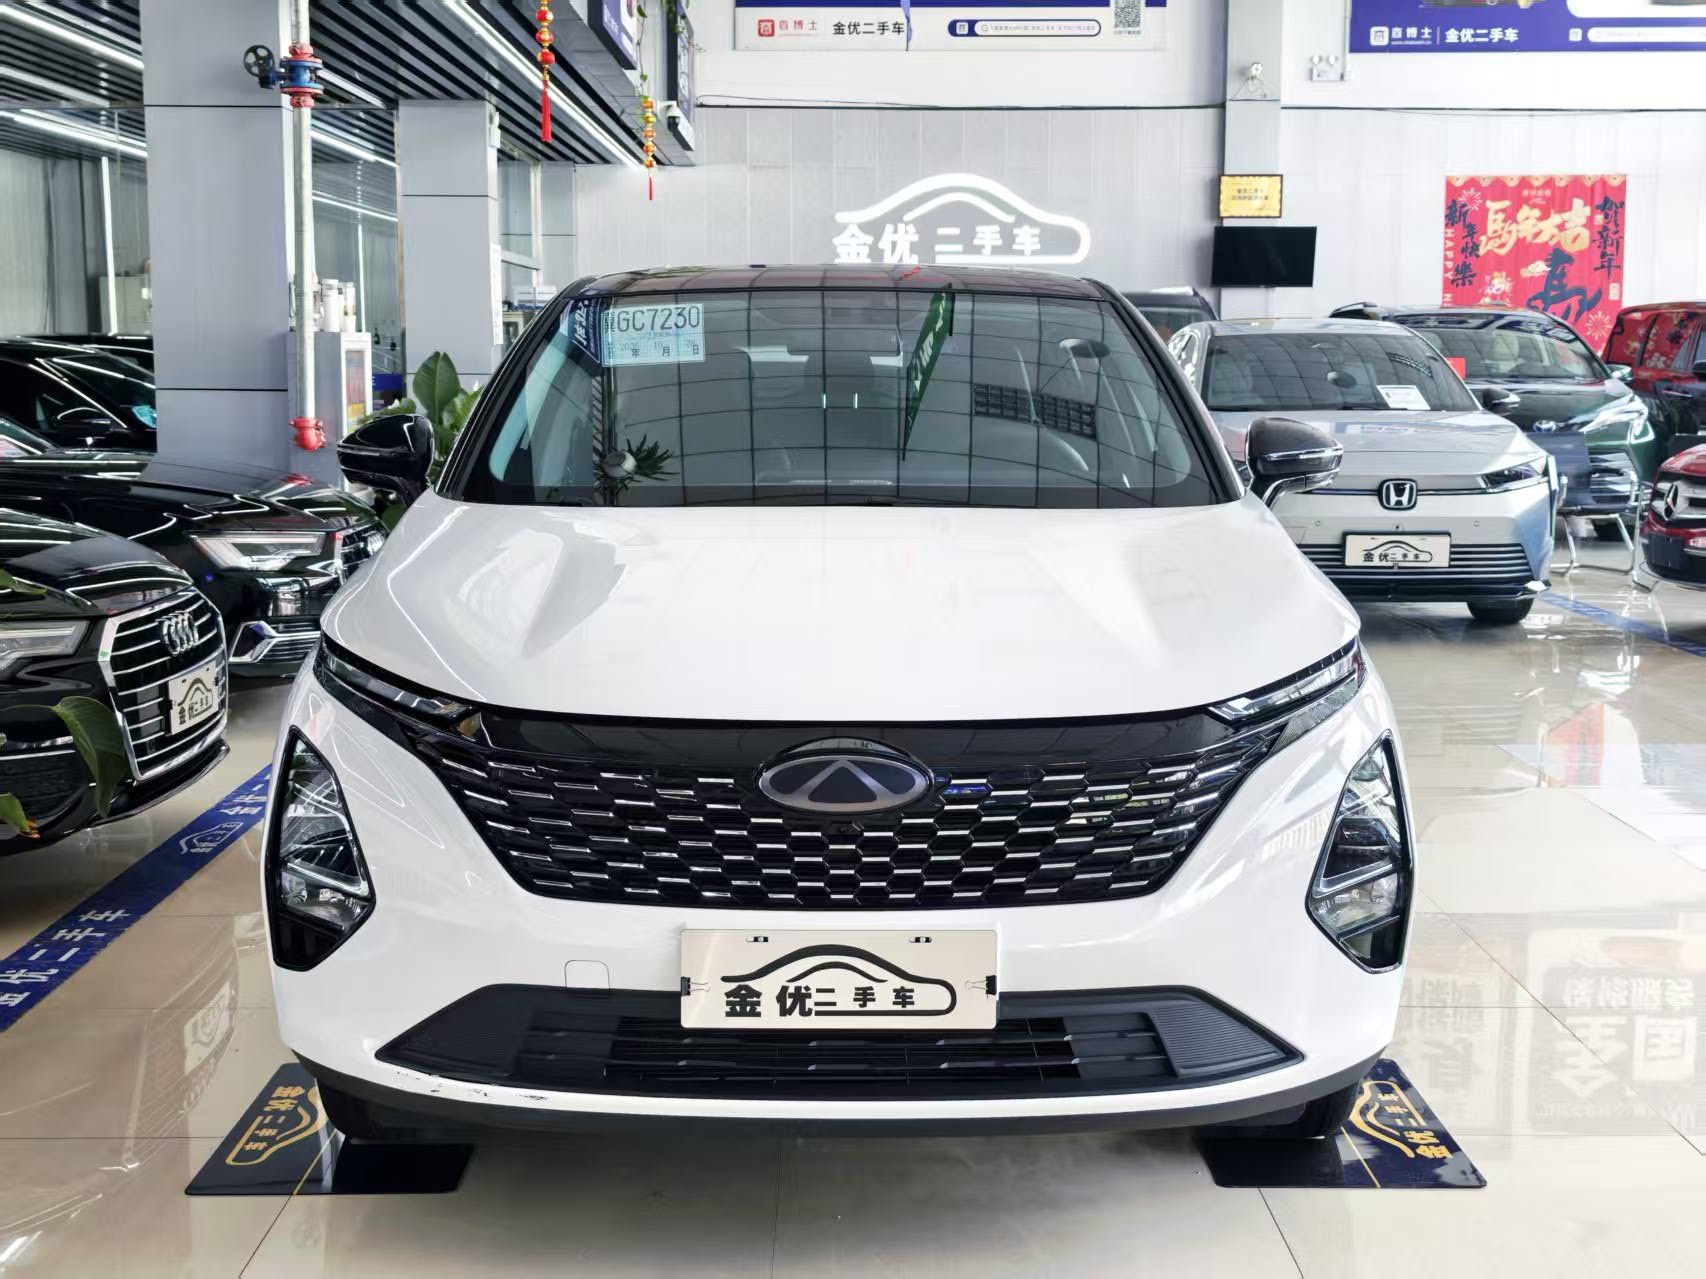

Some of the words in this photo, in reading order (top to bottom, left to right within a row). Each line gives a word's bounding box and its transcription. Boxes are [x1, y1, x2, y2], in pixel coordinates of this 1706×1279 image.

[833, 21, 905, 35] 金优二手车
[1445, 28, 1519, 42] 金优二手车
[832, 223, 1041, 264] 金优二手车
[1444, 228, 1455, 280] HAPPY
[1363, 552, 1420, 562] 金优二手车
[724, 984, 915, 1017] 金优二手车
